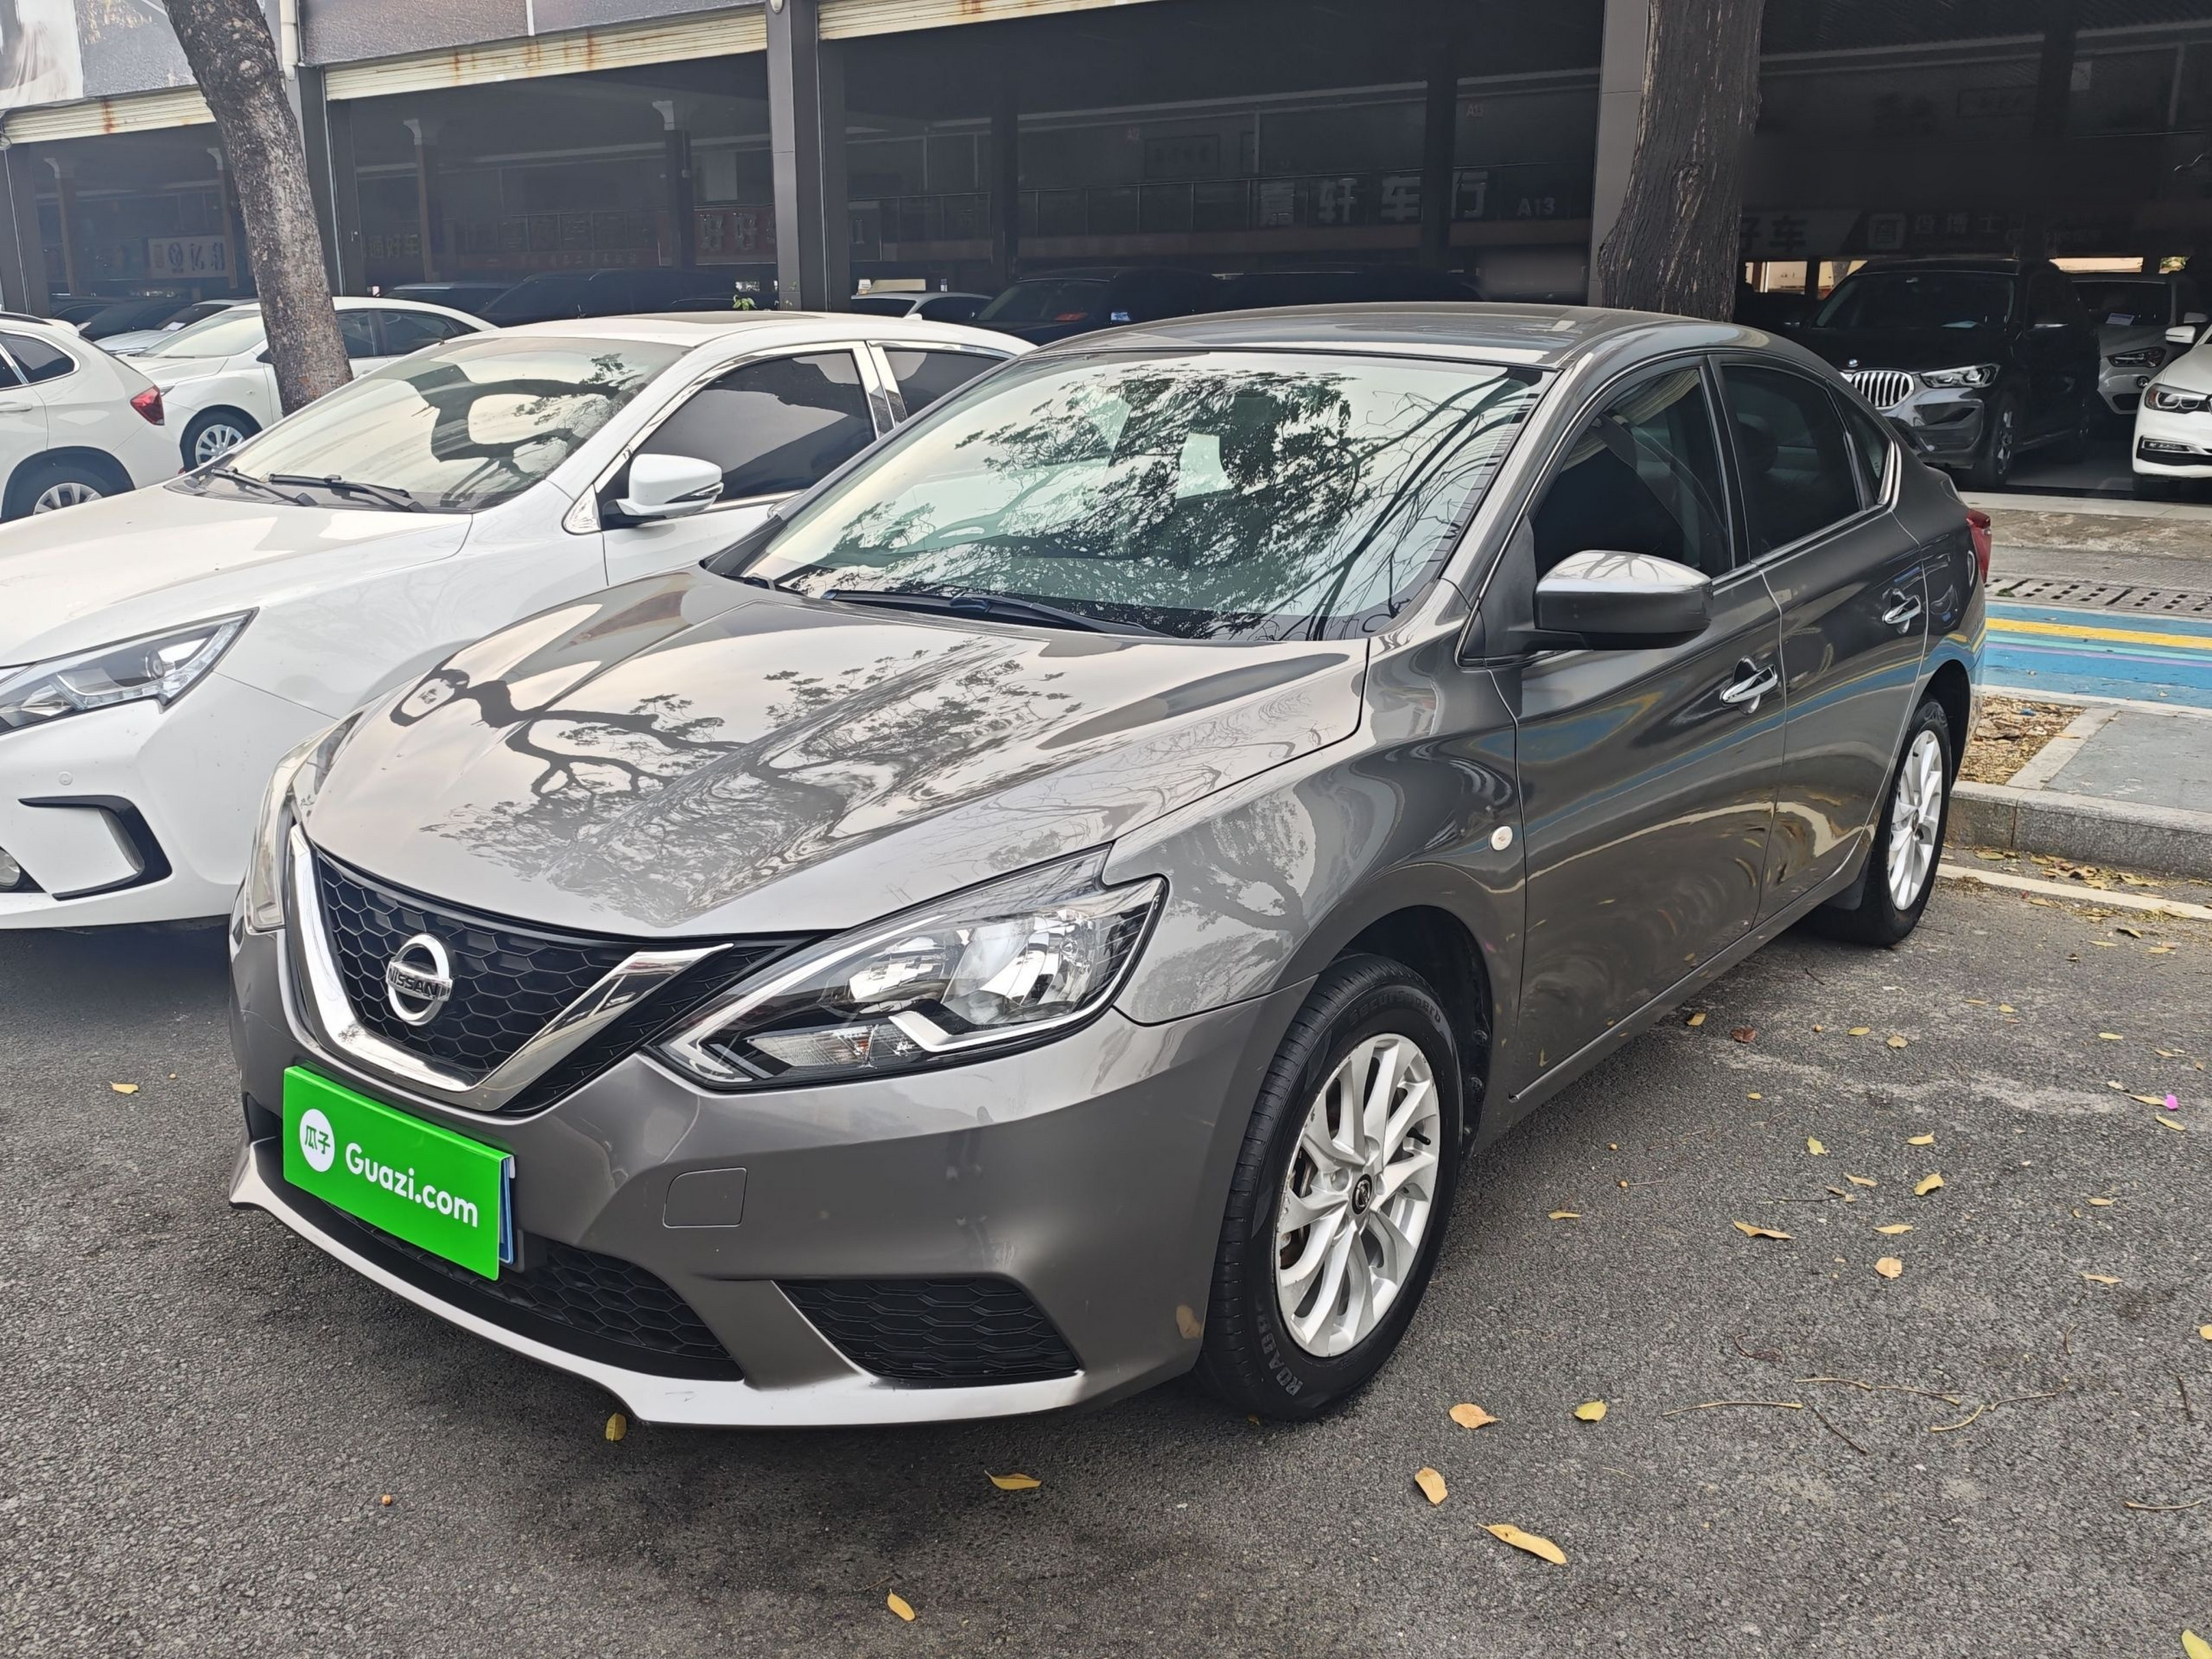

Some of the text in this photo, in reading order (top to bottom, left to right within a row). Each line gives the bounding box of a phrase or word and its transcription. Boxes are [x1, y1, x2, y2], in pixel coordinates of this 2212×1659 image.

[388, 967, 440, 999] NISSAN
[304, 1124, 331, 1156] 瓜子
[346, 1143, 478, 1228] Guazi.com
